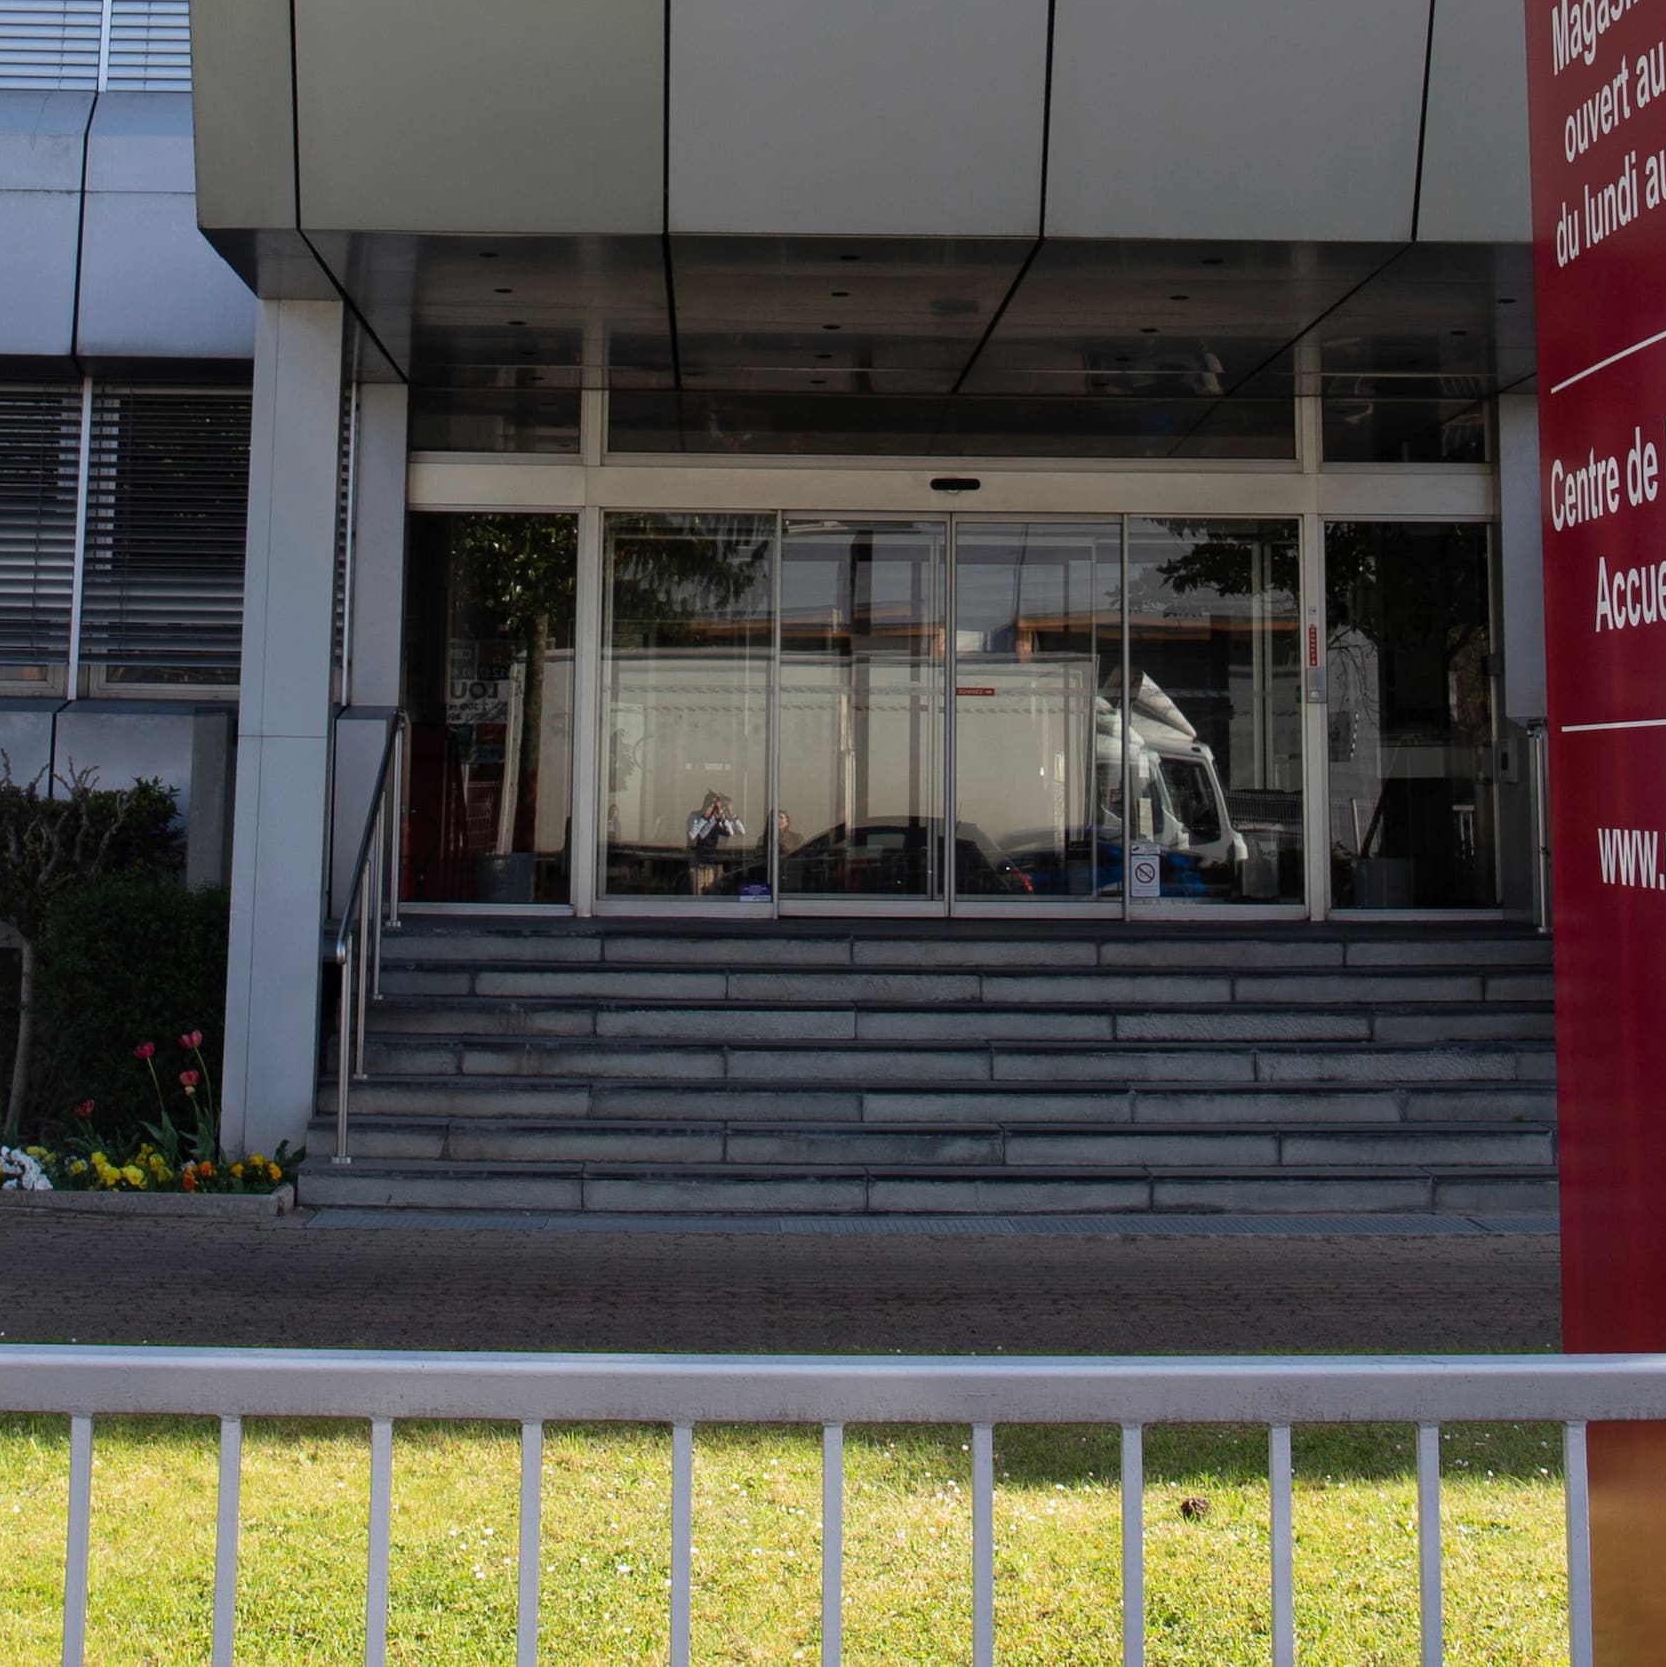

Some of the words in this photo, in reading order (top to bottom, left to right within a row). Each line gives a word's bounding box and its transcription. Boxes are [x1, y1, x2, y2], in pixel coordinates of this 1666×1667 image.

[1564, 55, 1631, 163] ouvert
[1636, 41, 1666, 109] au
[1556, 202, 1580, 268] du
[1585, 150, 1638, 250] lundi
[1550, 447, 1620, 532] Centre
[1627, 427, 1658, 506] de
